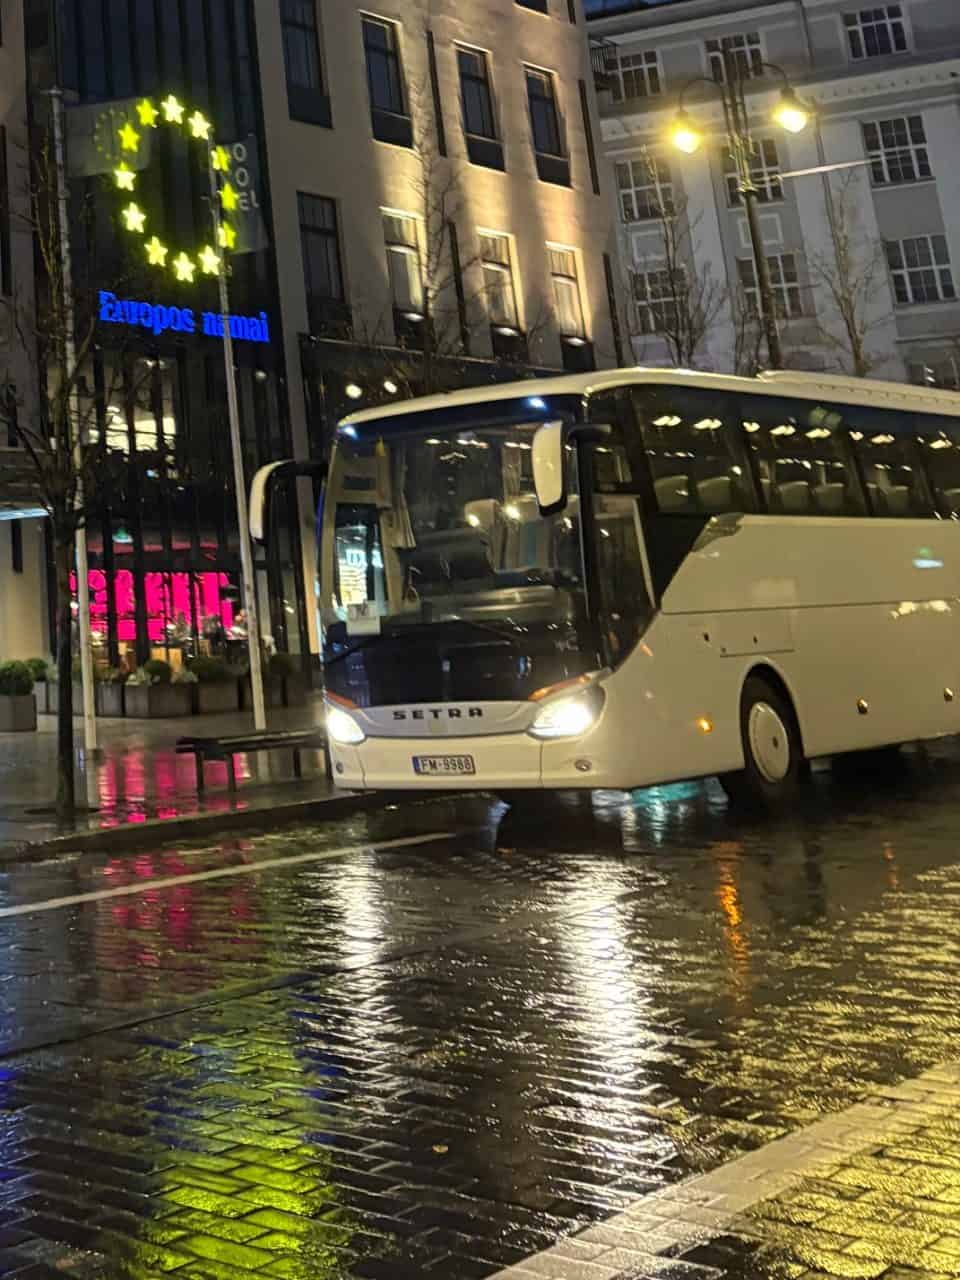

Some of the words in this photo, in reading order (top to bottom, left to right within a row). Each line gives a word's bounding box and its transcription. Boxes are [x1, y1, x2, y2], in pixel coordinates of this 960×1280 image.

[98, 289, 195, 336] Europos
[202, 310, 270, 343] namai
[393, 707, 483, 720] SETRA
